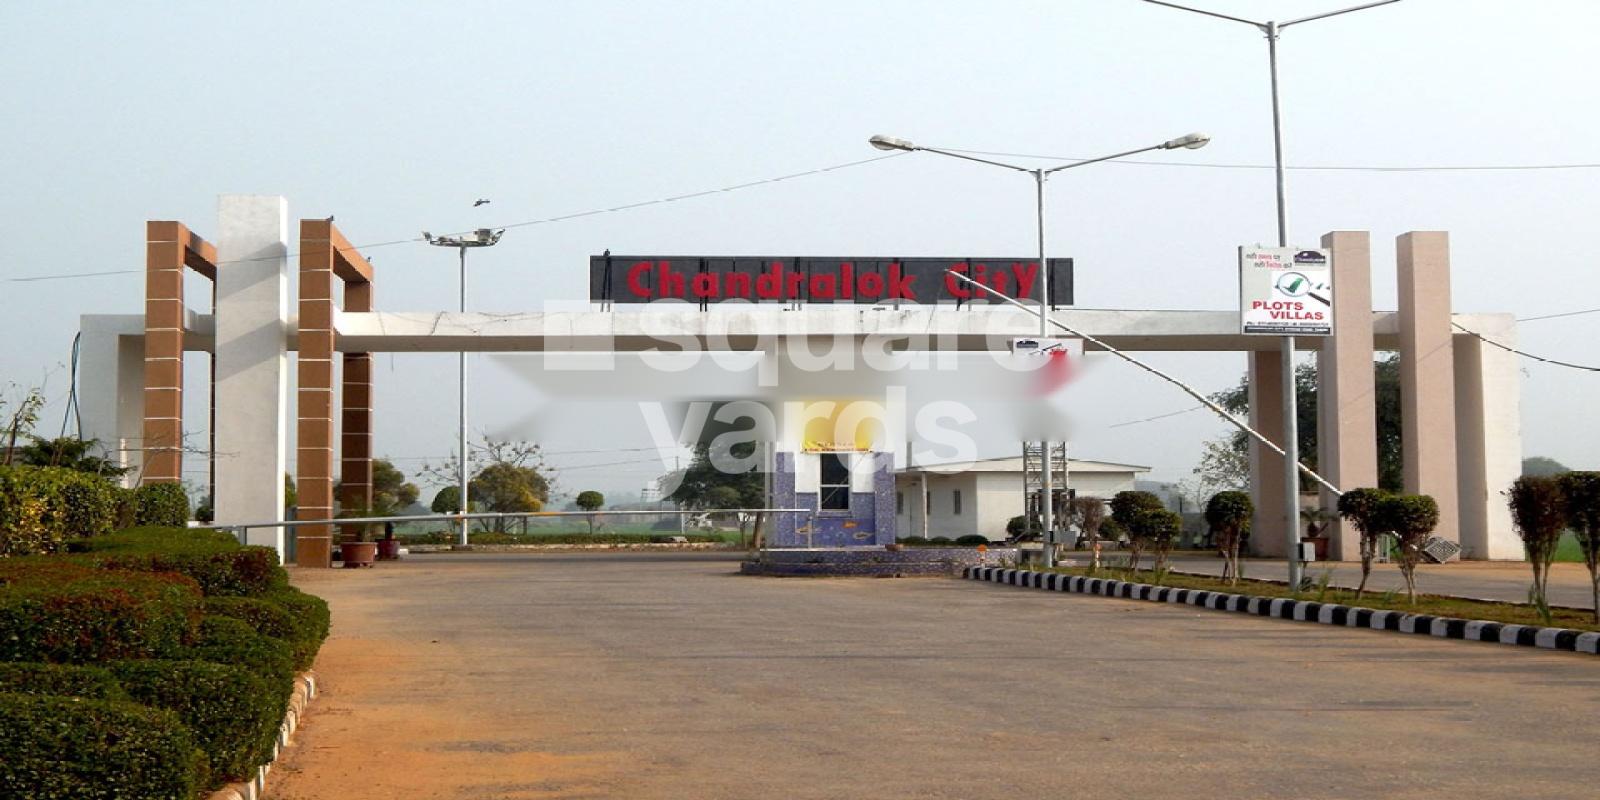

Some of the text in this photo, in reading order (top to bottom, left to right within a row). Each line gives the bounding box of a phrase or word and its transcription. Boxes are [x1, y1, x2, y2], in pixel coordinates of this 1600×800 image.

[627, 261, 1040, 299] Chandralok City
[1252, 301, 1304, 310] PLOTS
[1270, 311, 1324, 320] VILLAS
